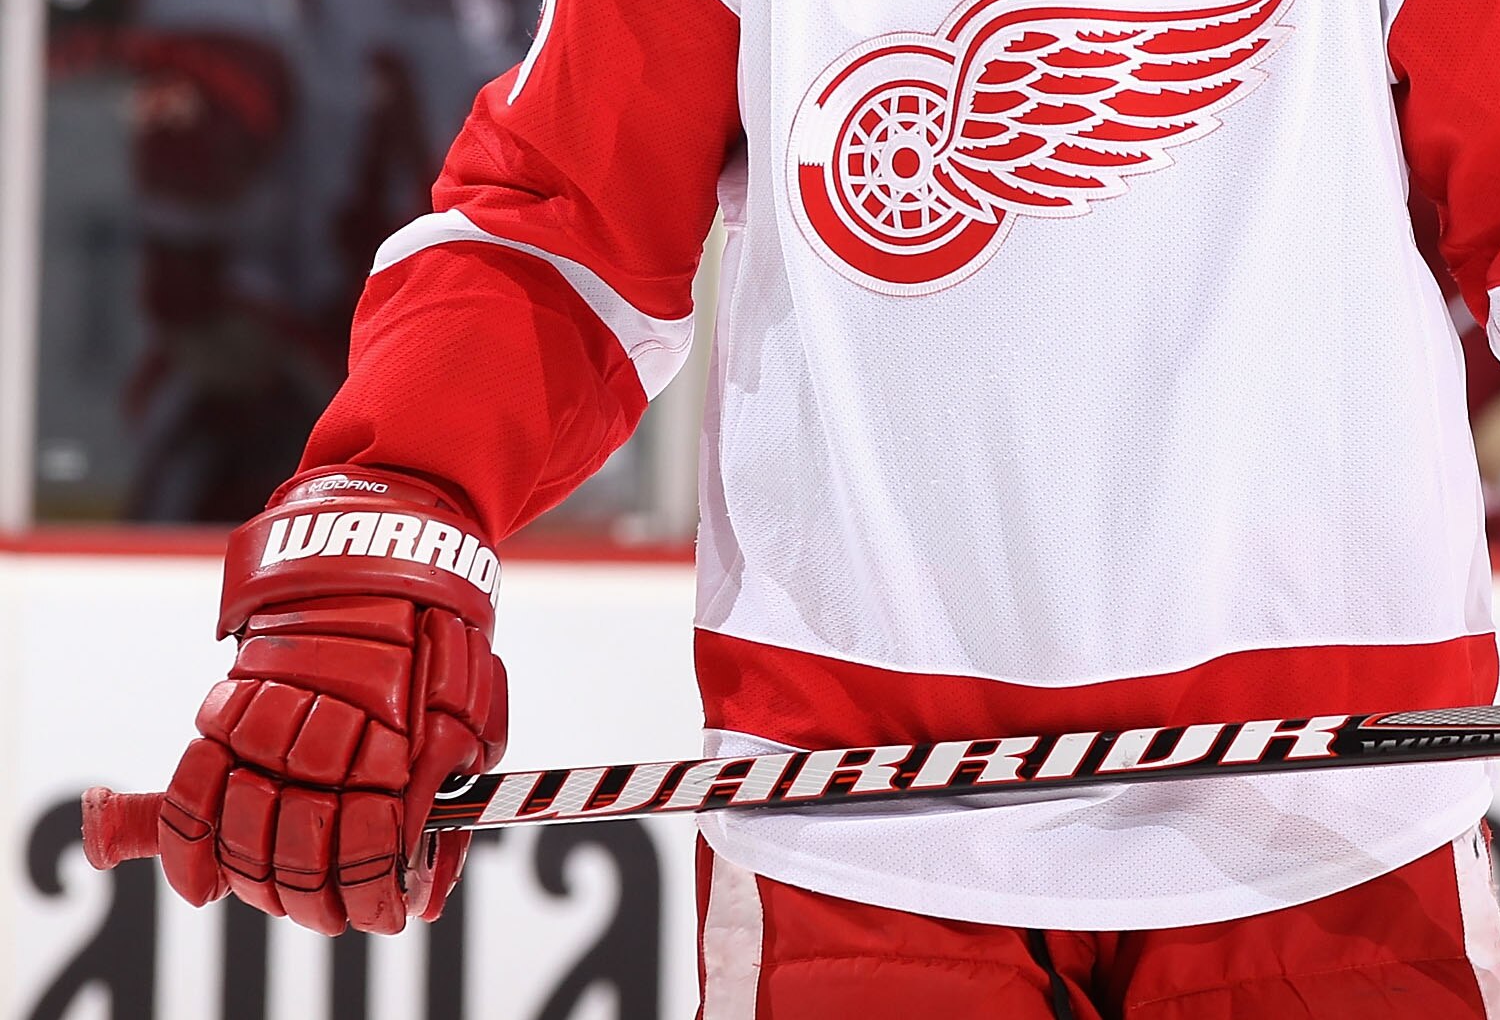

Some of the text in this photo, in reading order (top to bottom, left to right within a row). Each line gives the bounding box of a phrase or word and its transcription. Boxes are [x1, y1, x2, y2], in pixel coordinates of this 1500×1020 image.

[308, 479, 389, 494] MODANO
[259, 510, 501, 609] WARRIO
[477, 713, 1351, 823] WARRIOR
